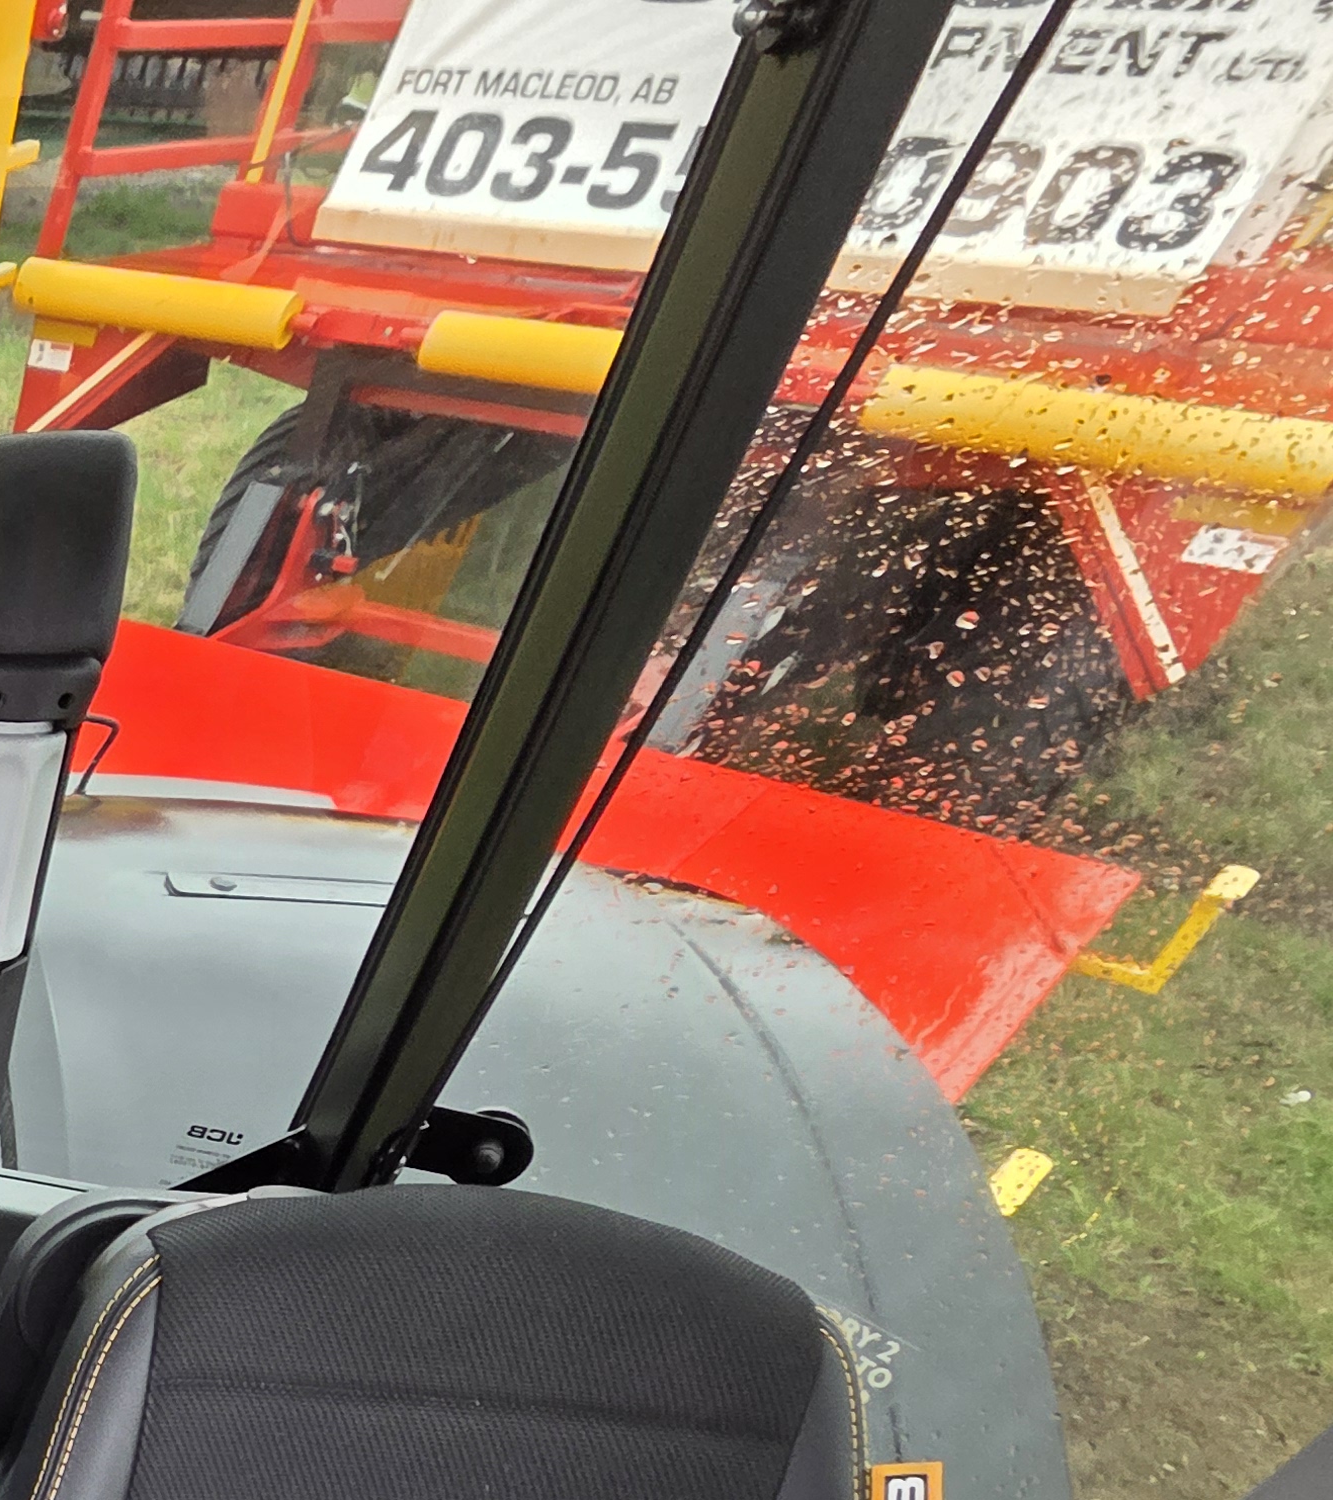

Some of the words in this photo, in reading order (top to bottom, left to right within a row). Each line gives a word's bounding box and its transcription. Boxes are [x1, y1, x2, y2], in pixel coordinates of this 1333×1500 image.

[396, 69, 471, 97] FORT
[474, 71, 621, 107] MACLEOD,
[630, 74, 680, 105] AB
[186, 1125, 244, 1145] JCB
